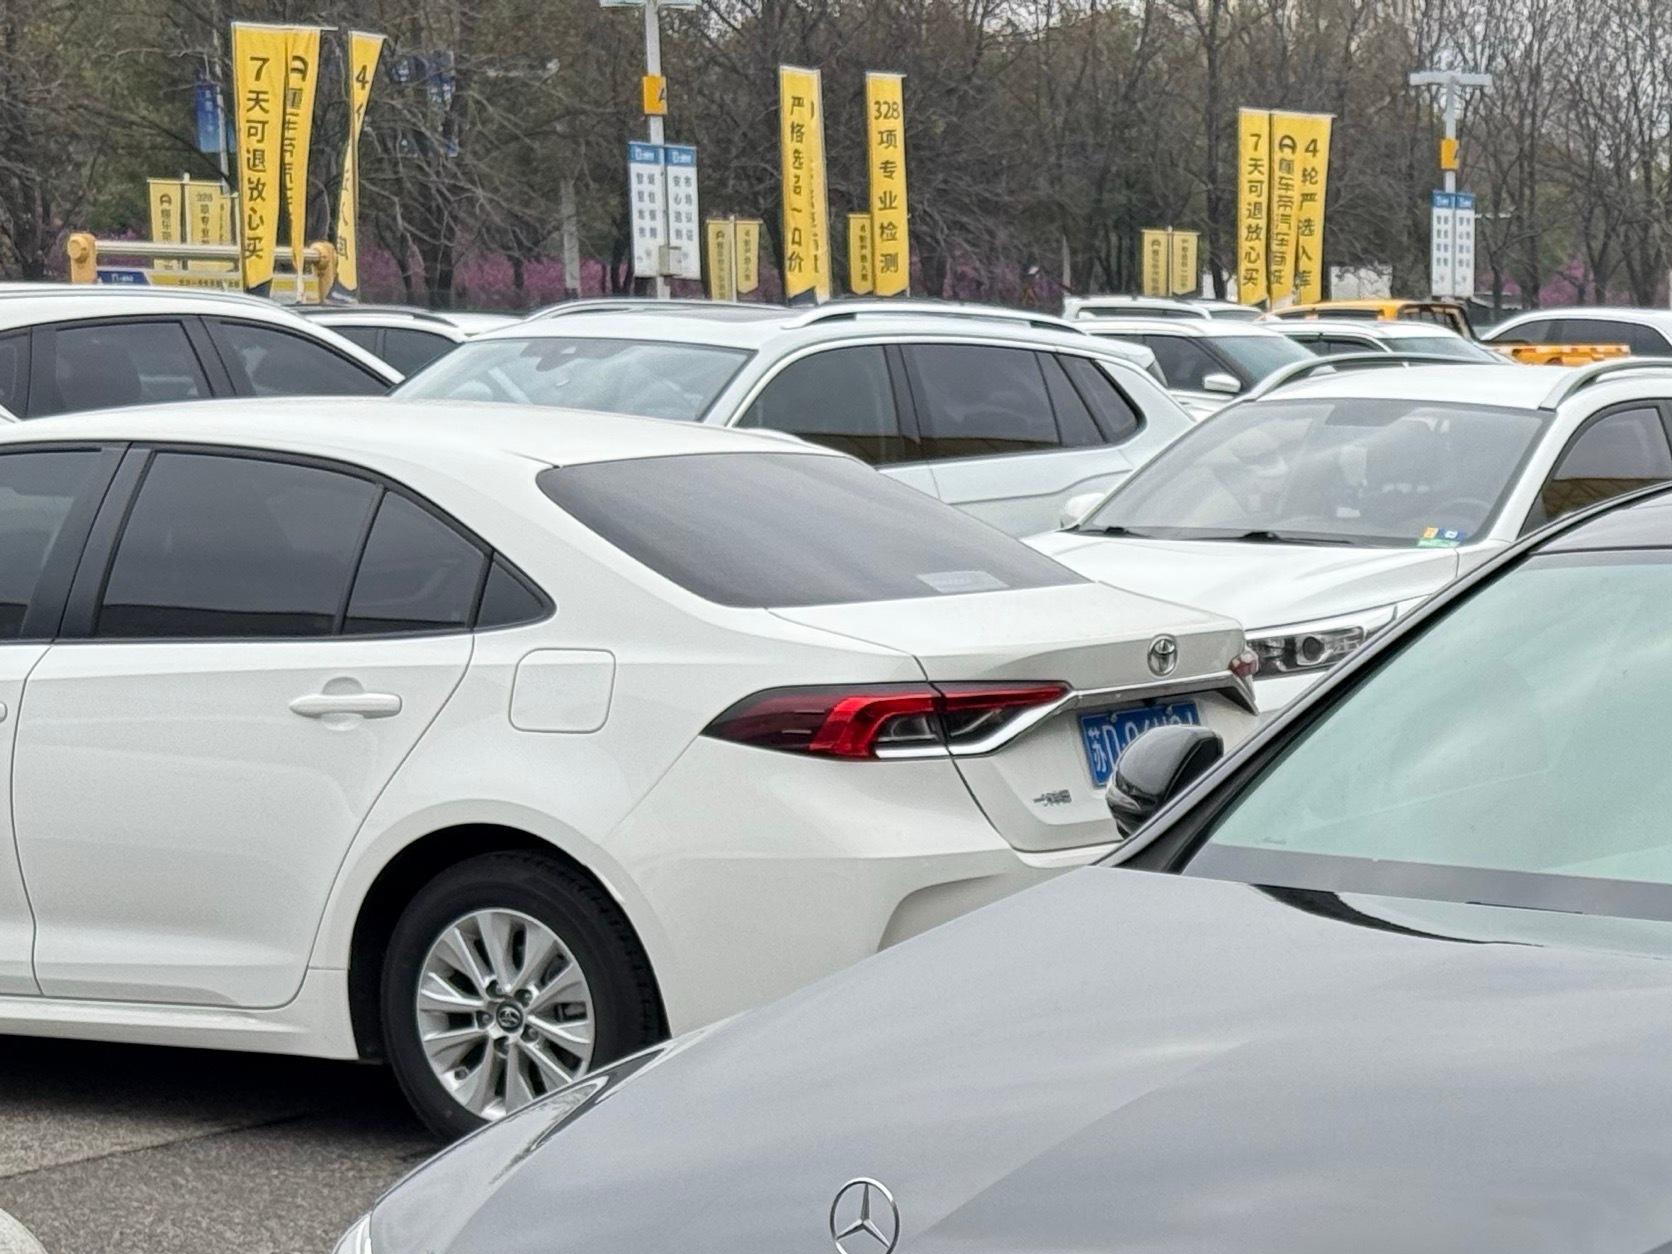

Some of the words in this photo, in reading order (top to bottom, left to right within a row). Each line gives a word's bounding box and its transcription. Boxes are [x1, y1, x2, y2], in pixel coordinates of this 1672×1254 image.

[244, 56, 270, 260] 7天可退放心买
[873, 100, 900, 274] 328项专业检测
[1242, 133, 1265, 287] 7天可退放心买
